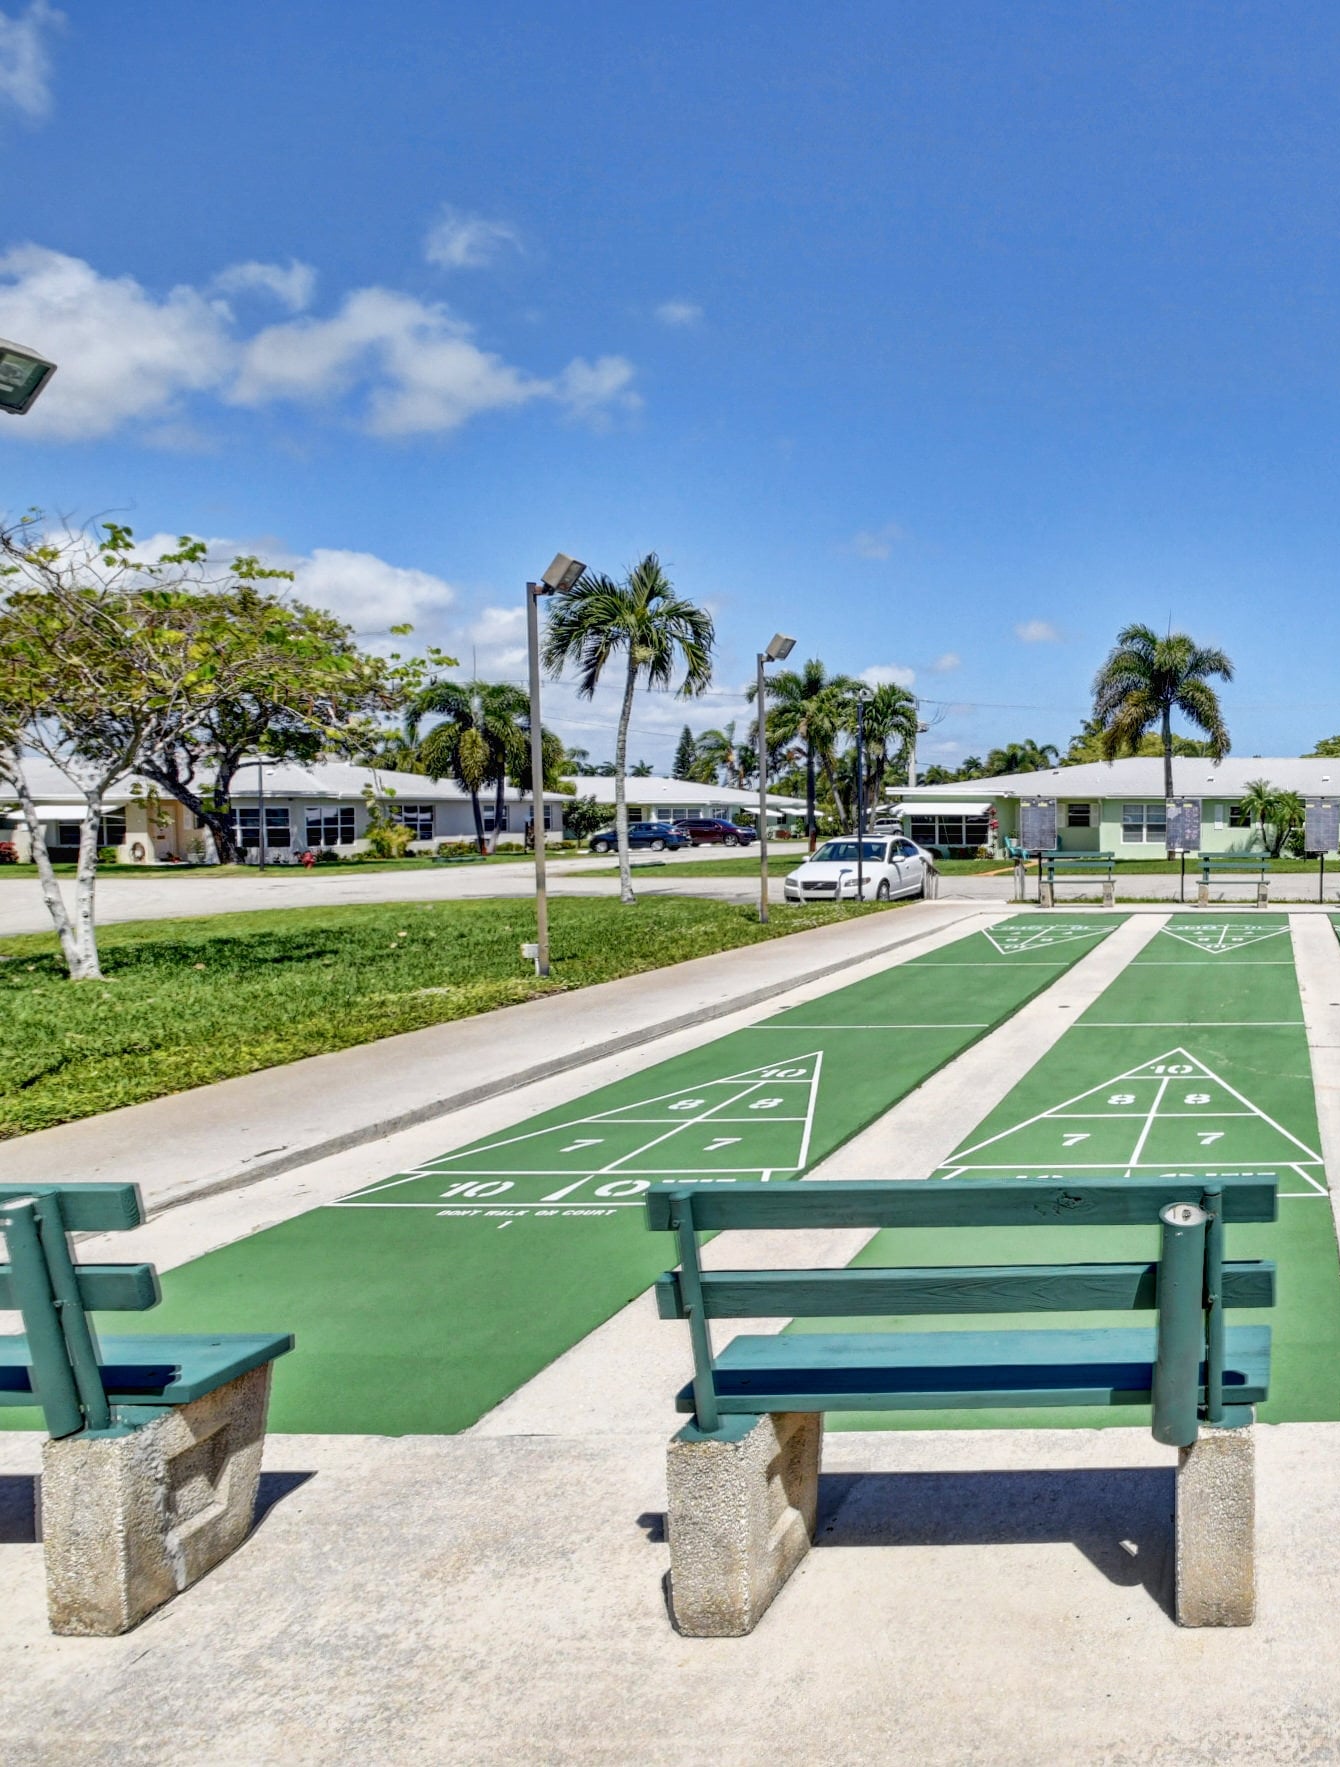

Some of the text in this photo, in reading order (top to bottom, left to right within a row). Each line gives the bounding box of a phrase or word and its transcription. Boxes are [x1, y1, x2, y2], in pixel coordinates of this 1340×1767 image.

[760, 1068, 808, 1078] 10
[1150, 1064, 1194, 1074] 10
[667, 1098, 705, 1110] 8
[748, 1097, 784, 1109] 8
[1107, 1093, 1136, 1105] 8
[1183, 1093, 1211, 1105] 8
[703, 1137, 743, 1151] 7
[1061, 1132, 1092, 1147] 7
[1196, 1131, 1225, 1146] 7
[559, 1138, 605, 1153] 7
[439, 1180, 515, 1198] 10
[483, 1209, 530, 1217] WALK
[534, 1209, 560, 1217] ON
[561, 1209, 618, 1217] COURT
[497, 1220, 513, 1229] 1
